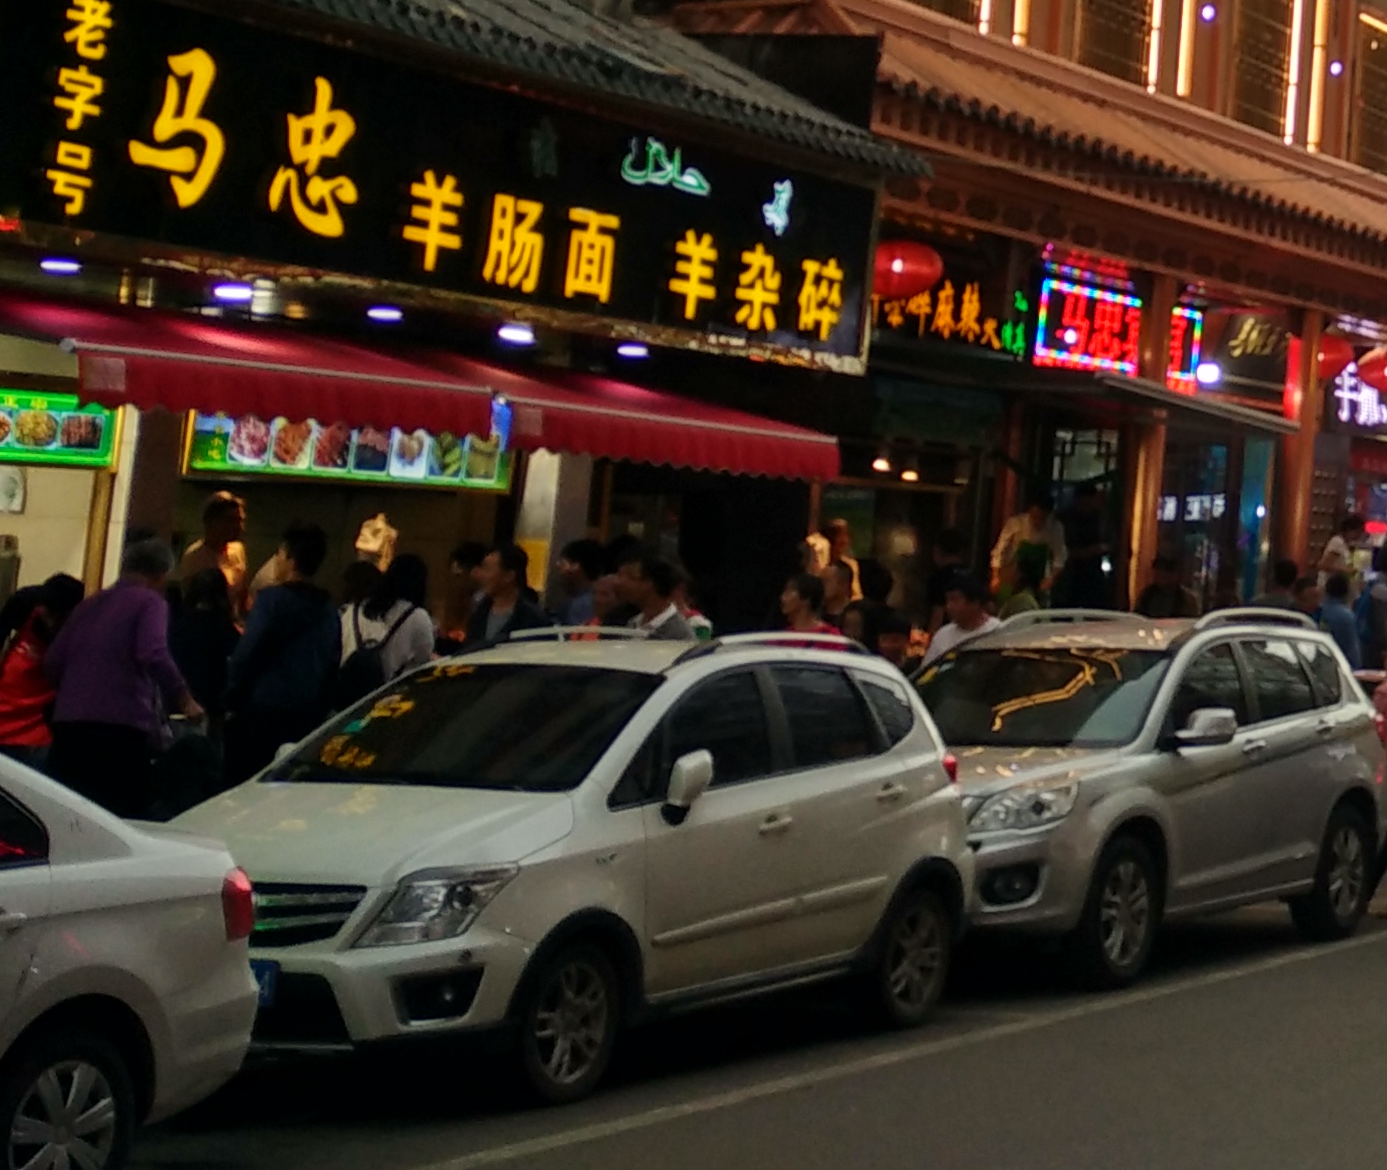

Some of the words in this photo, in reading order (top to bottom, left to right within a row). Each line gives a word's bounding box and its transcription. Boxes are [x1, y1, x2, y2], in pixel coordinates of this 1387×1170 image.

[128, 46, 359, 239] 马忠
[402, 168, 621, 304] 羊肠面
[667, 229, 843, 342] 羊杂碎
